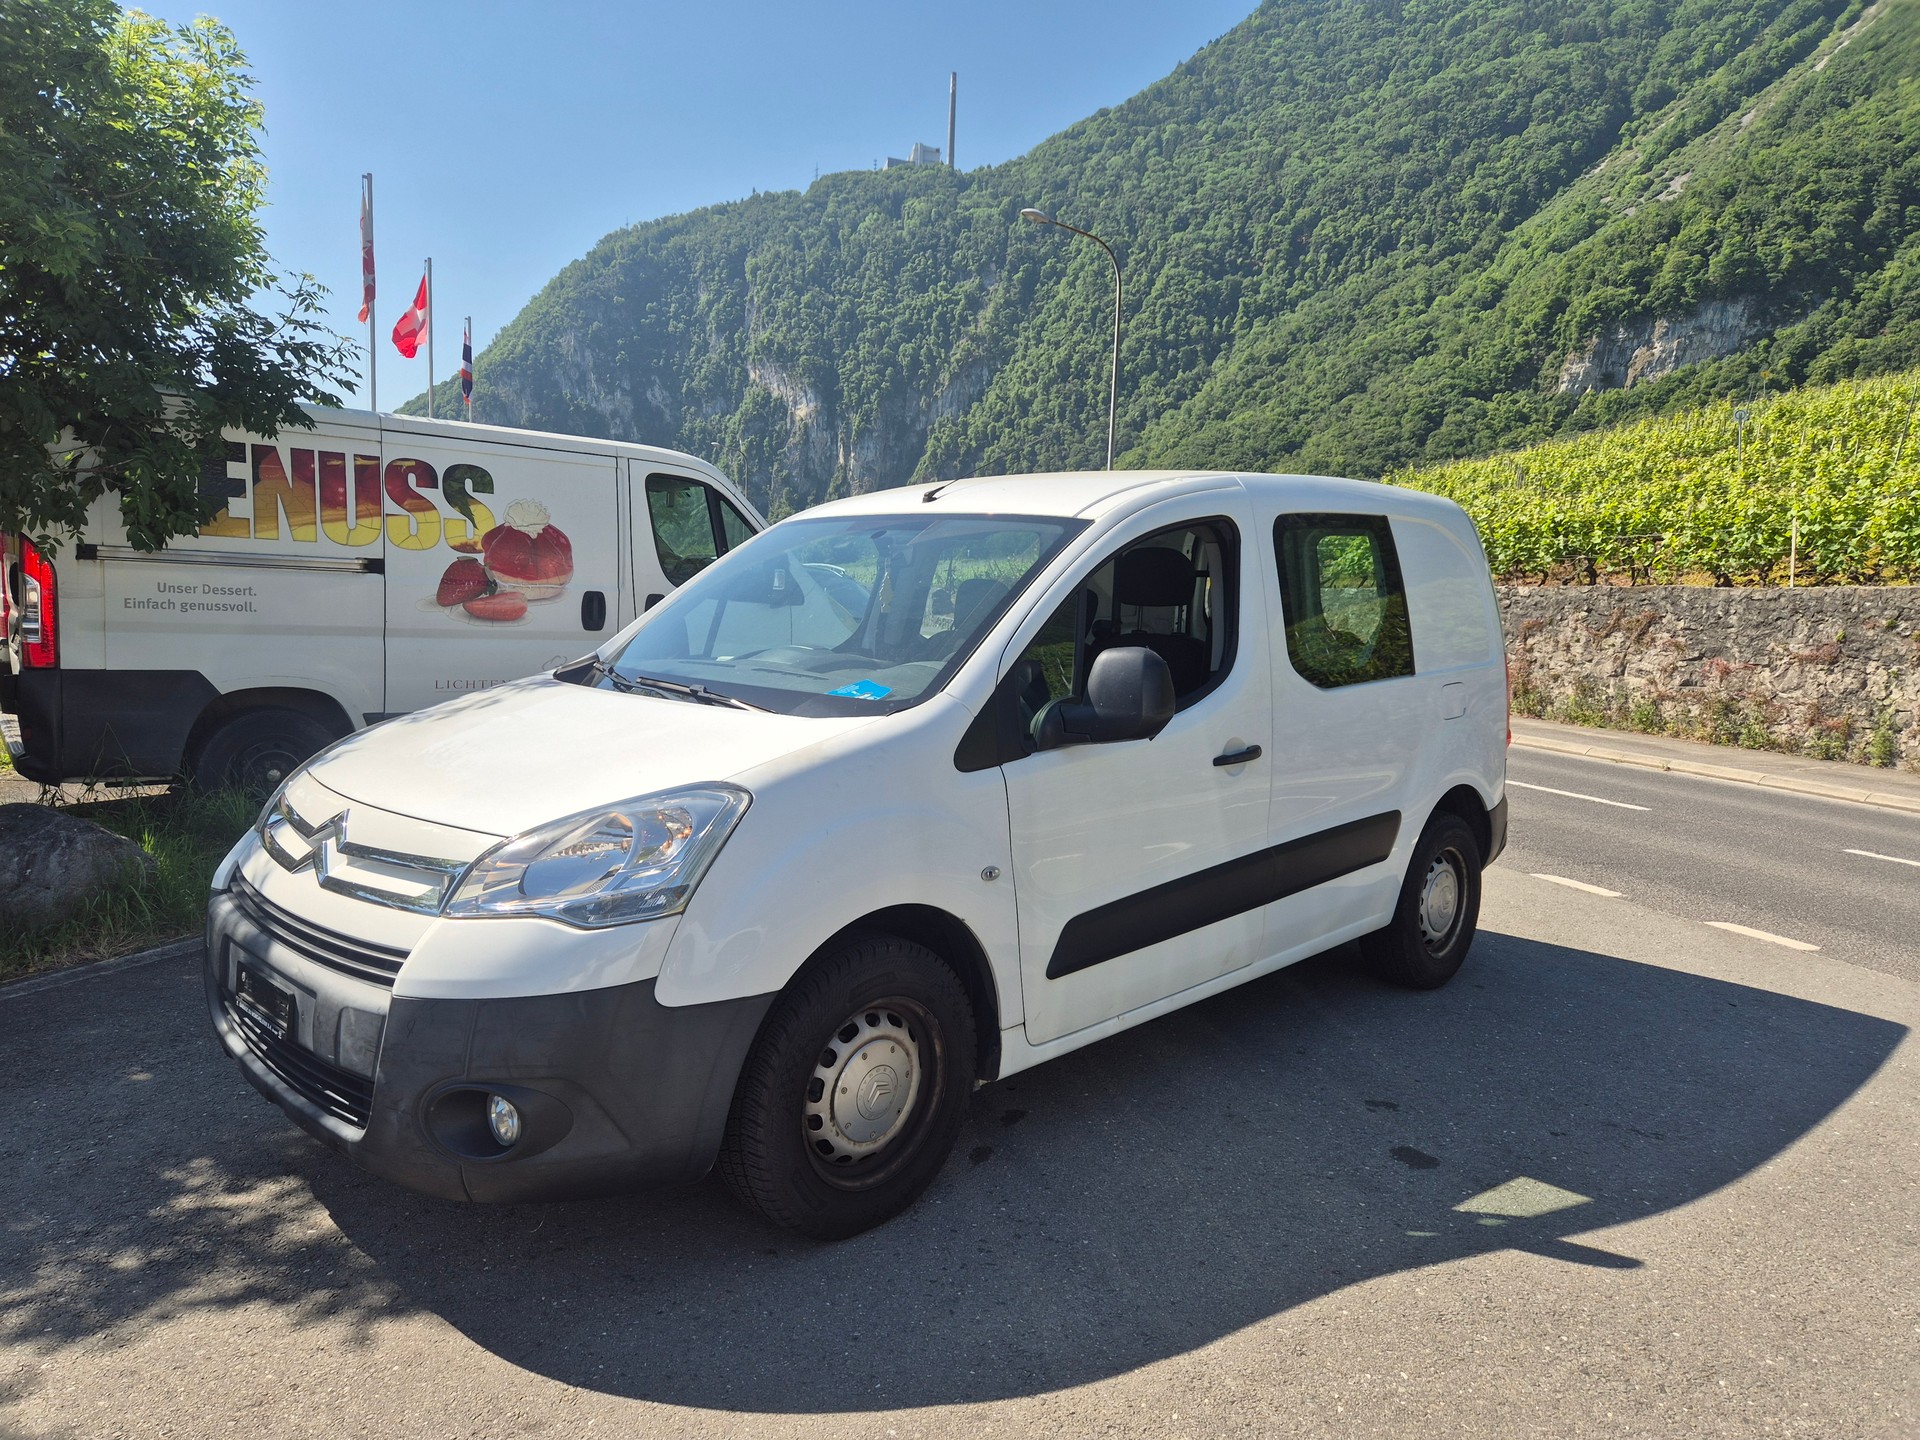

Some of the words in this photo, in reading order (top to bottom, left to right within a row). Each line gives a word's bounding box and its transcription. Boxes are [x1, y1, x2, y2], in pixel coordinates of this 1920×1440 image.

[122, 434, 495, 554] ENUSS
[157, 582, 198, 594] Unser
[202, 583, 257, 596] Dessert.
[123, 597, 176, 610] Einfach
[180, 600, 257, 613] genussvoll.
